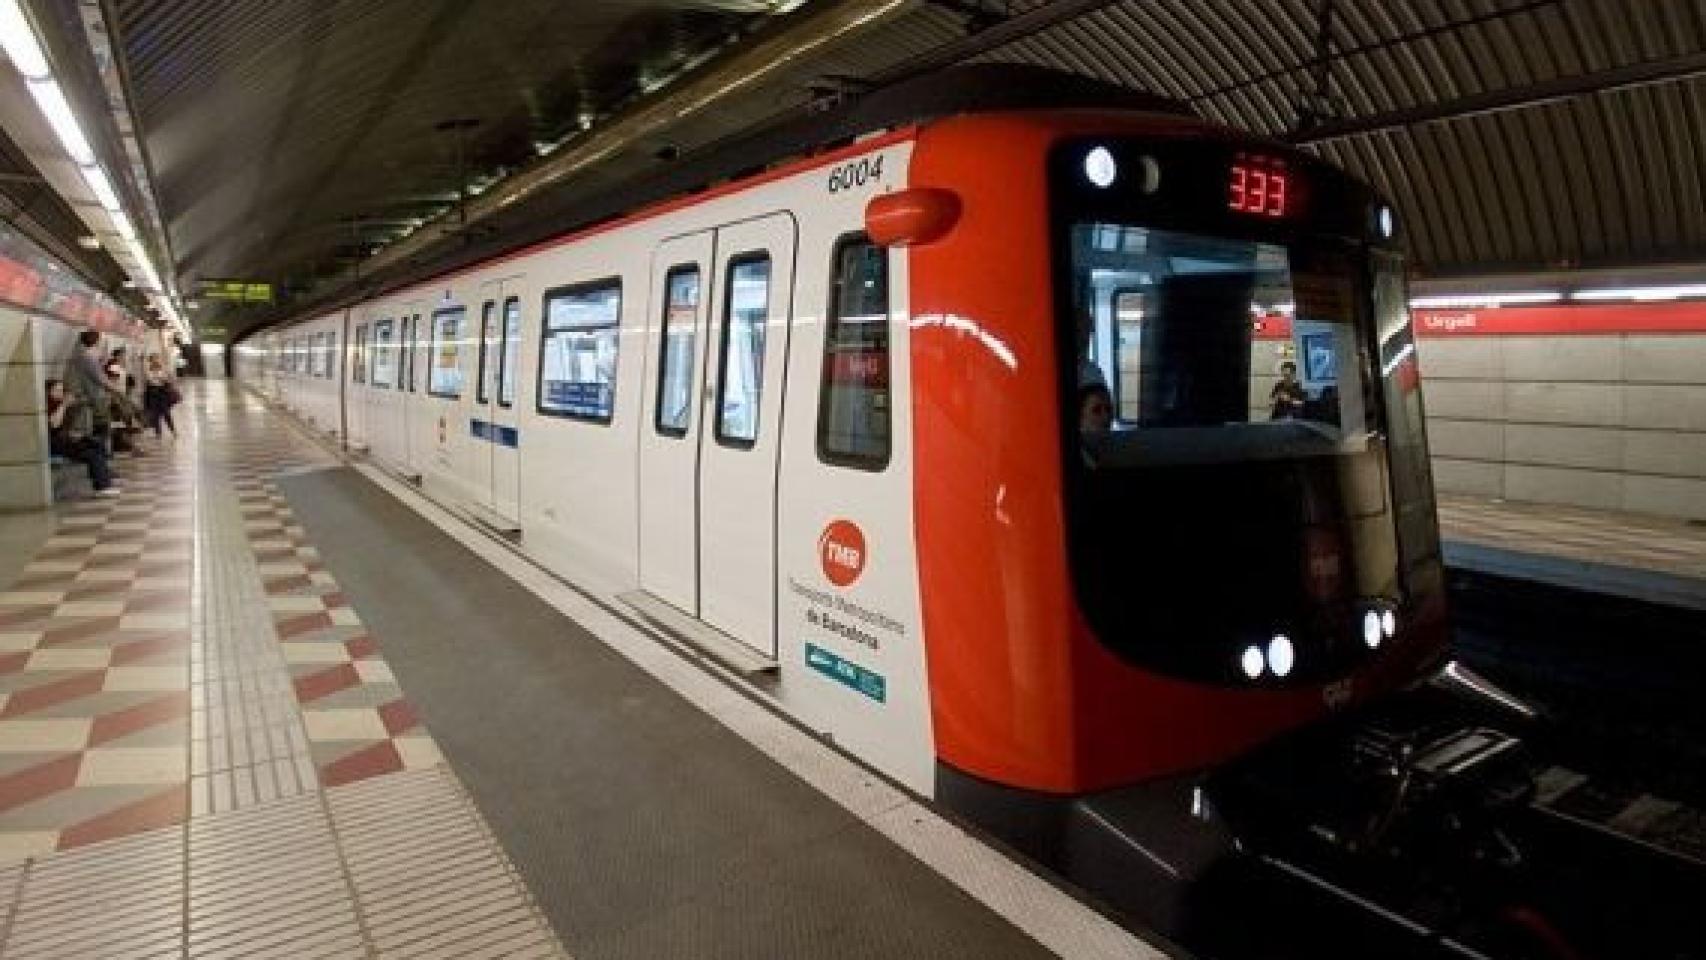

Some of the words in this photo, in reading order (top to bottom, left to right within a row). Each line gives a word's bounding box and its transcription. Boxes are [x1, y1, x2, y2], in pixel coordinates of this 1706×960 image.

[829, 154, 883, 192] 6004
[1228, 166, 1285, 216] 333
[1423, 313, 1476, 330] Urgell
[822, 613, 879, 650] Barcelona
